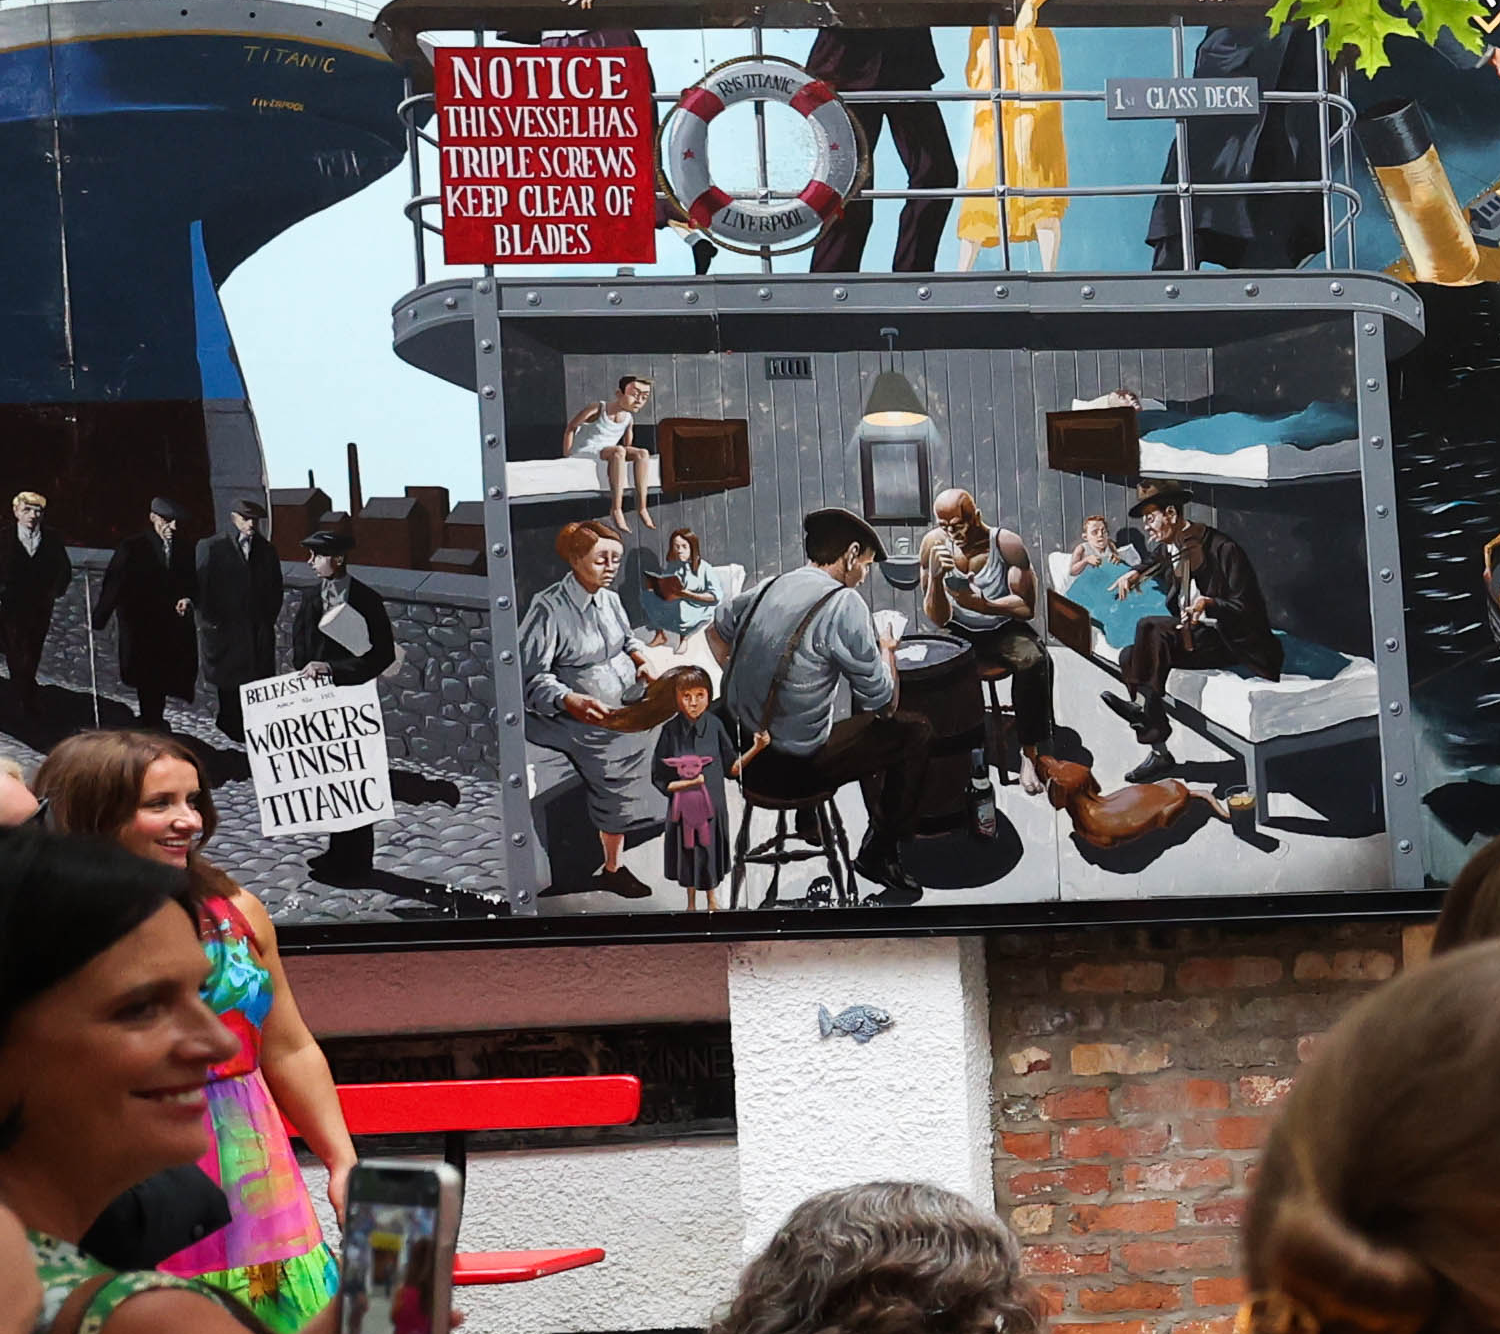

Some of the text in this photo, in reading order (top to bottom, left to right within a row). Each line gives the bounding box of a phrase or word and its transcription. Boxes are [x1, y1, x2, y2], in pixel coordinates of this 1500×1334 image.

[243, 45, 336, 73] TITANIC
[450, 56, 628, 100] NOTICE
[717, 73, 796, 98] RMS TITANIC
[1147, 85, 1253, 109] CLASS DECK
[444, 106, 639, 138] THIS VESSEL HAS
[443, 146, 636, 179] TRIPLE SCREWS
[445, 185, 635, 217] KEEP CLEAR OF
[721, 208, 807, 232] LIVERPOOL
[494, 224, 592, 255] BLADES
[246, 677, 308, 706] BELFAST
[246, 703, 381, 756] WORKERS
[267, 739, 367, 784] FINISH
[262, 777, 384, 828] TITANIC
